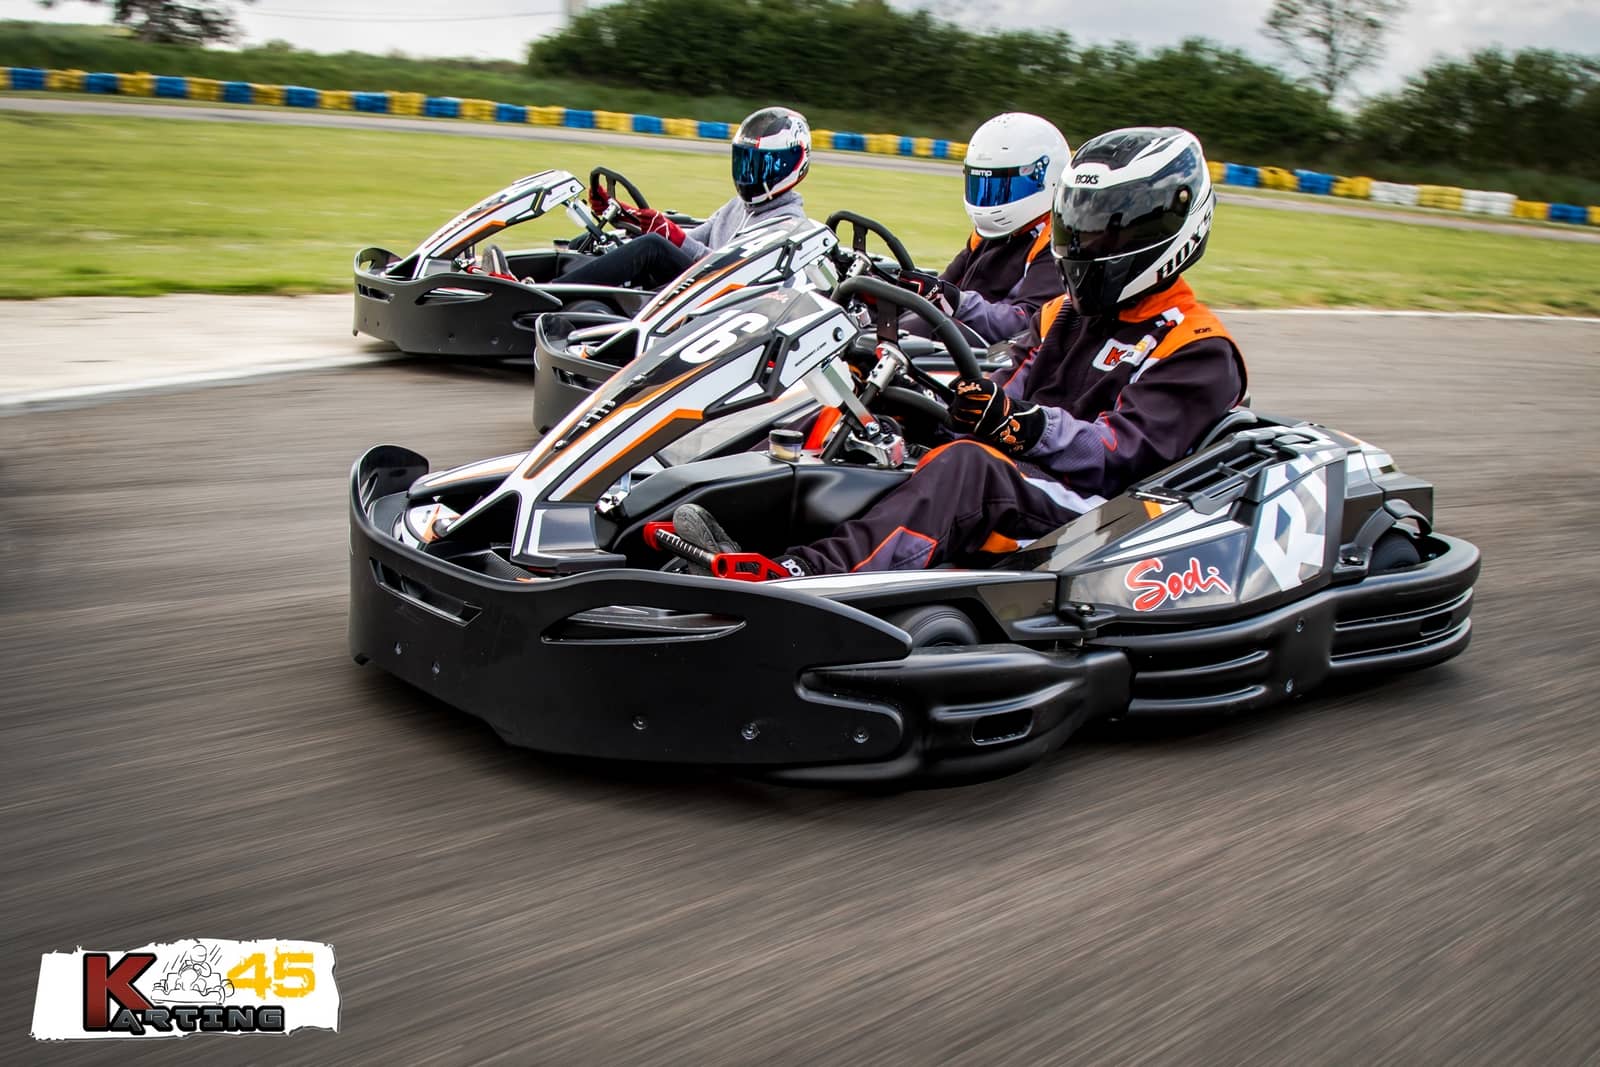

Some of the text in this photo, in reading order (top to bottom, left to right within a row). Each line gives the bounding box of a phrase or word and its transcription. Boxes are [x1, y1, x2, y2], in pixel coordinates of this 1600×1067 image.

[1074, 174, 1099, 185] BOXS
[781, 558, 806, 577] BO
[1125, 557, 1232, 612] Sodi
